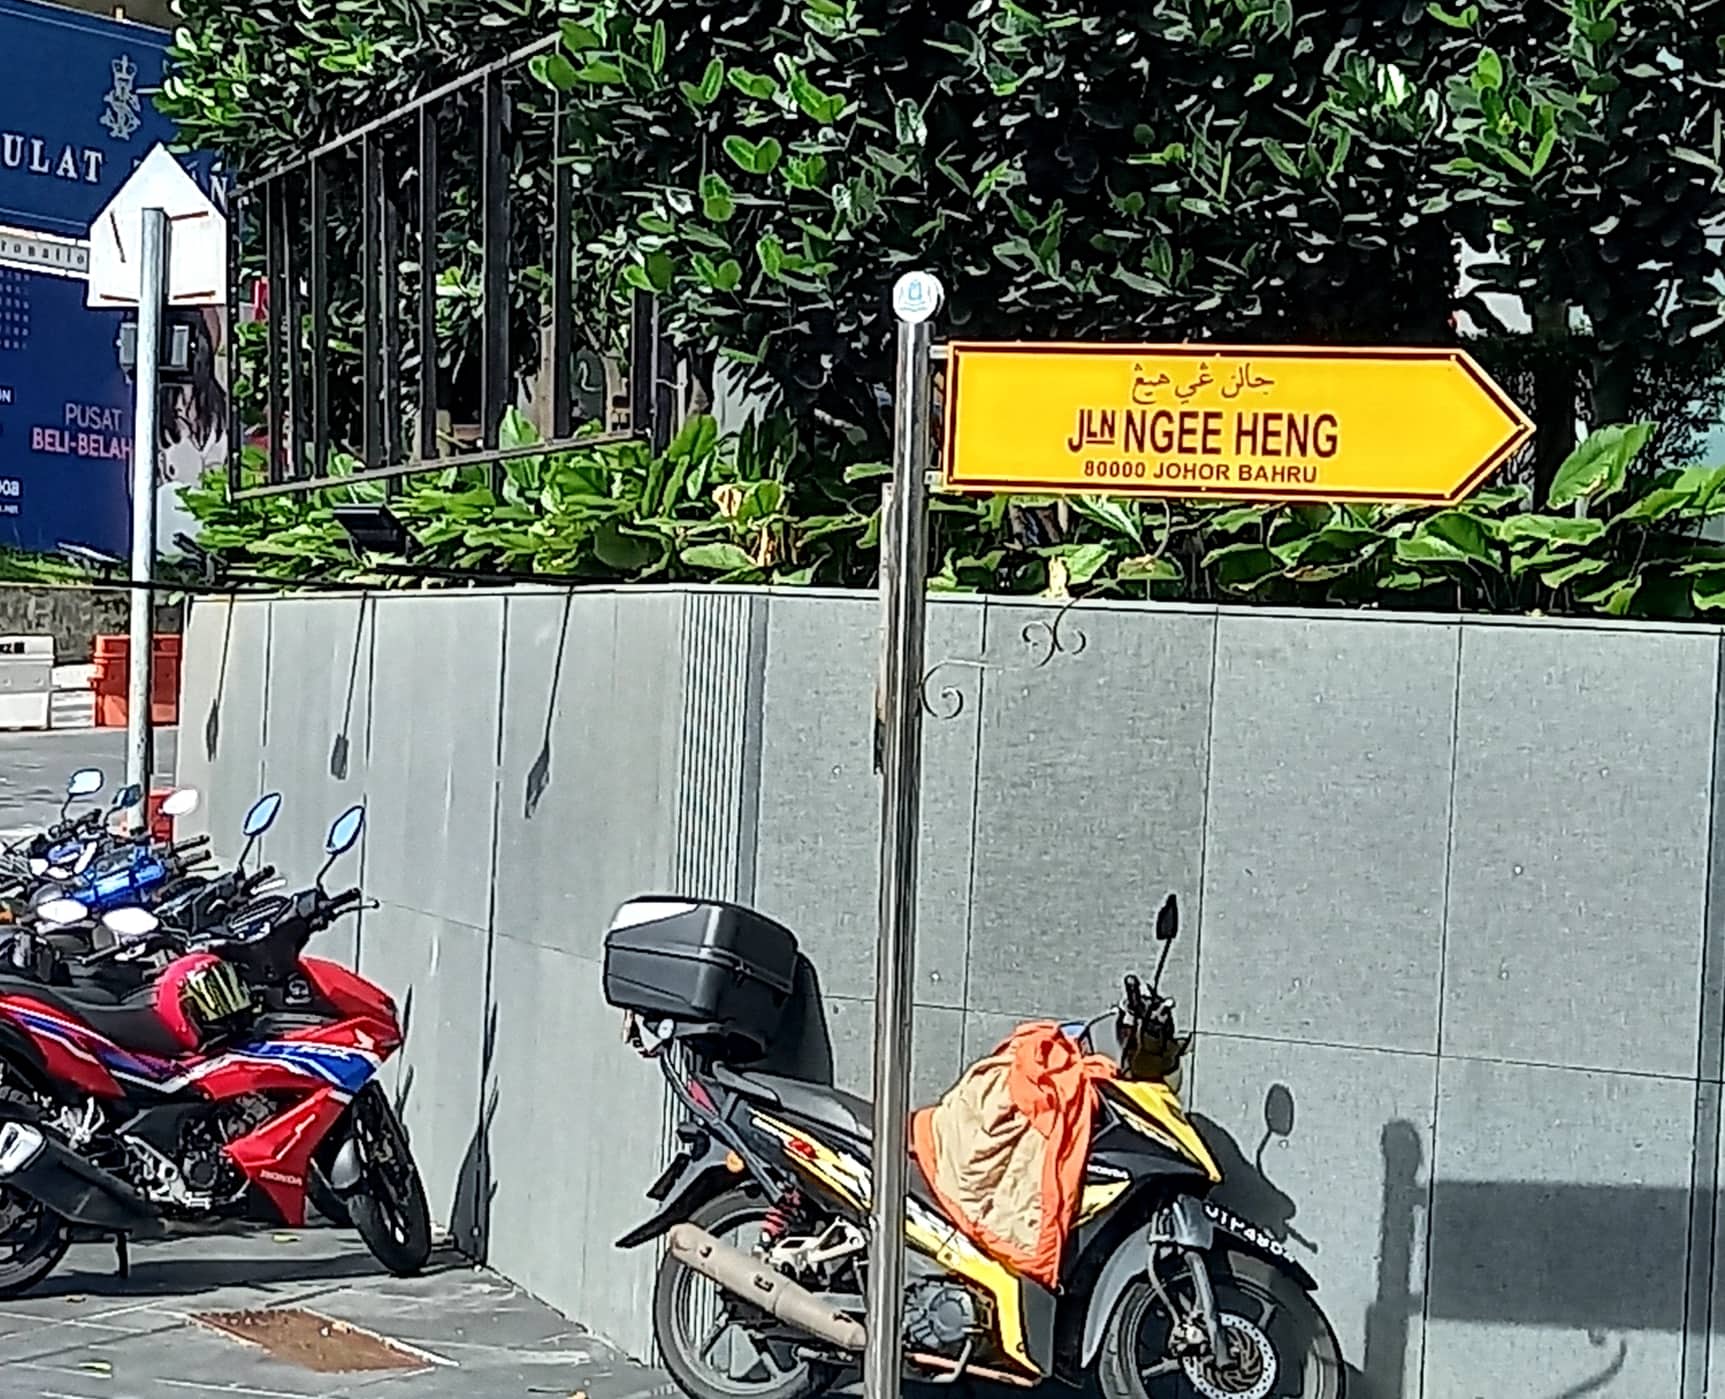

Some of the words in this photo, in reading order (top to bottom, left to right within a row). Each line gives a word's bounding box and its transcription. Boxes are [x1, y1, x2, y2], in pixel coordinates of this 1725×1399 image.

[2, 133, 103, 183] ULAT
[64, 402, 123, 432] PUSAT
[31, 426, 133, 460] BELI-BELAH
[1067, 409, 1116, 452] JLN
[1123, 409, 1224, 455] NGEE
[1234, 411, 1338, 458] HENG
[1083, 459, 1147, 479] 80000
[1152, 461, 1230, 481] JOHOR
[1237, 463, 1318, 484] BAHRU
[260, 1168, 303, 1187] HONDA
